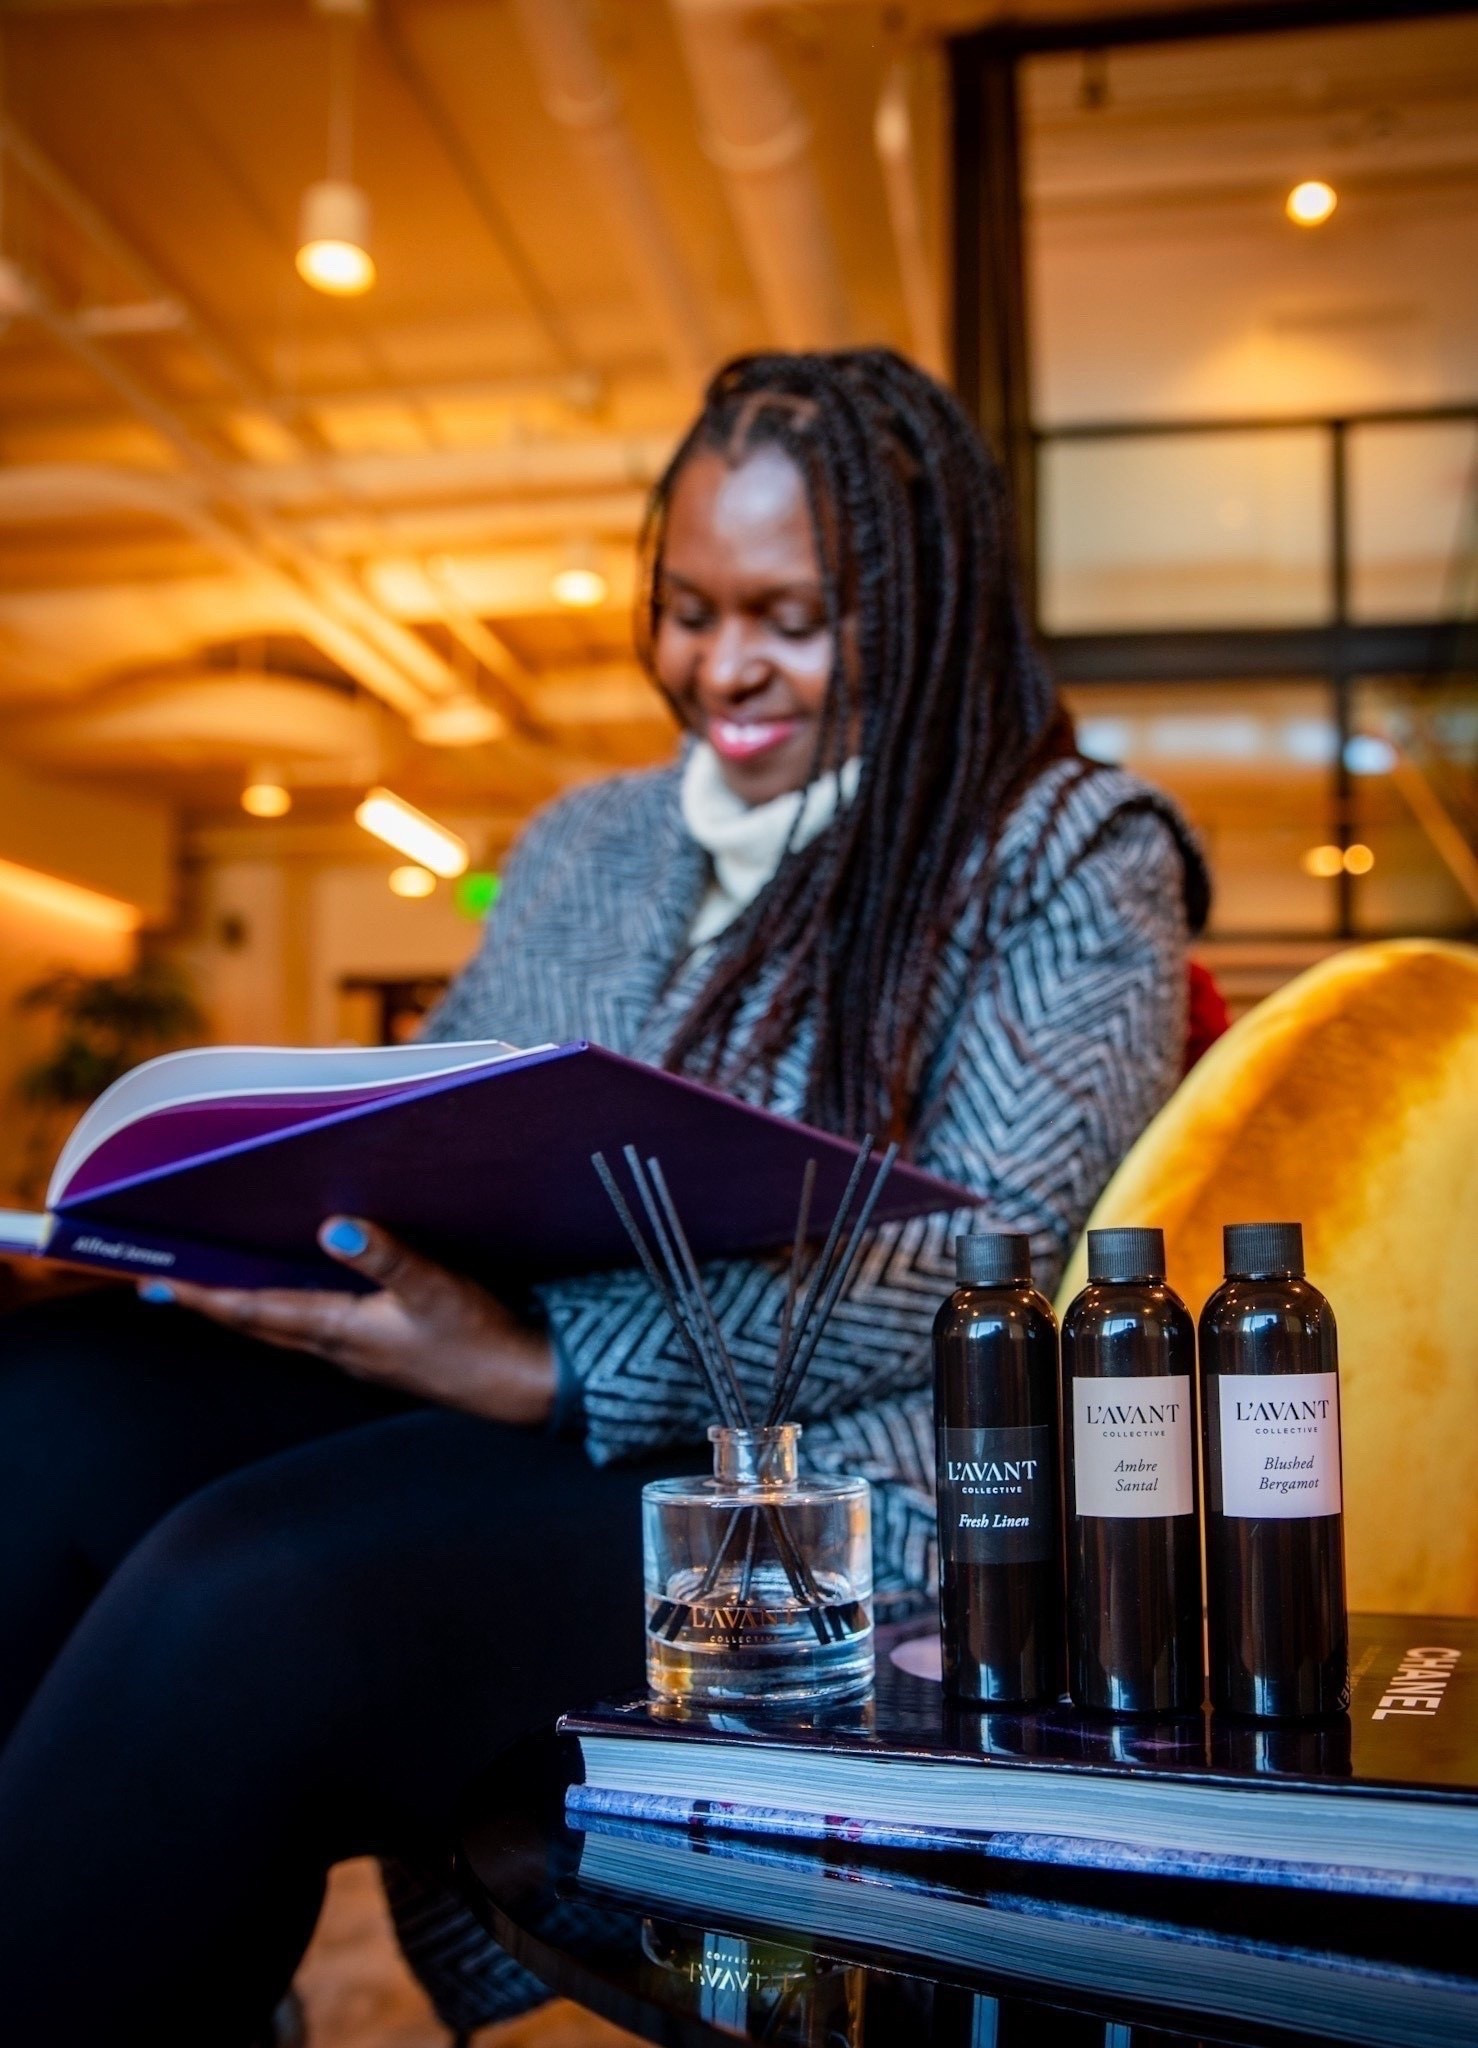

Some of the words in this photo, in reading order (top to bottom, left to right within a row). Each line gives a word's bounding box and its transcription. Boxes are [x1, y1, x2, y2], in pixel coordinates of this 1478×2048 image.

[1087, 1404, 1180, 1425] L'AVANT
[1236, 1400, 1330, 1421] L'AVANT
[1102, 1430, 1166, 1438] COLLECTIVE
[1255, 1427, 1318, 1435] COLLECTIVE
[1114, 1458, 1158, 1473] Ambre
[1264, 1455, 1315, 1470] Blushed
[948, 1460, 1038, 1482] L'AVANT
[961, 1486, 1022, 1494] COLLECTIVE
[1115, 1477, 1159, 1492] Santal
[1258, 1477, 1320, 1494] Bergamot
[958, 1513, 990, 1528] Fresh
[992, 1514, 1030, 1528] Linen
[1371, 1647, 1463, 1720] CHANEL
